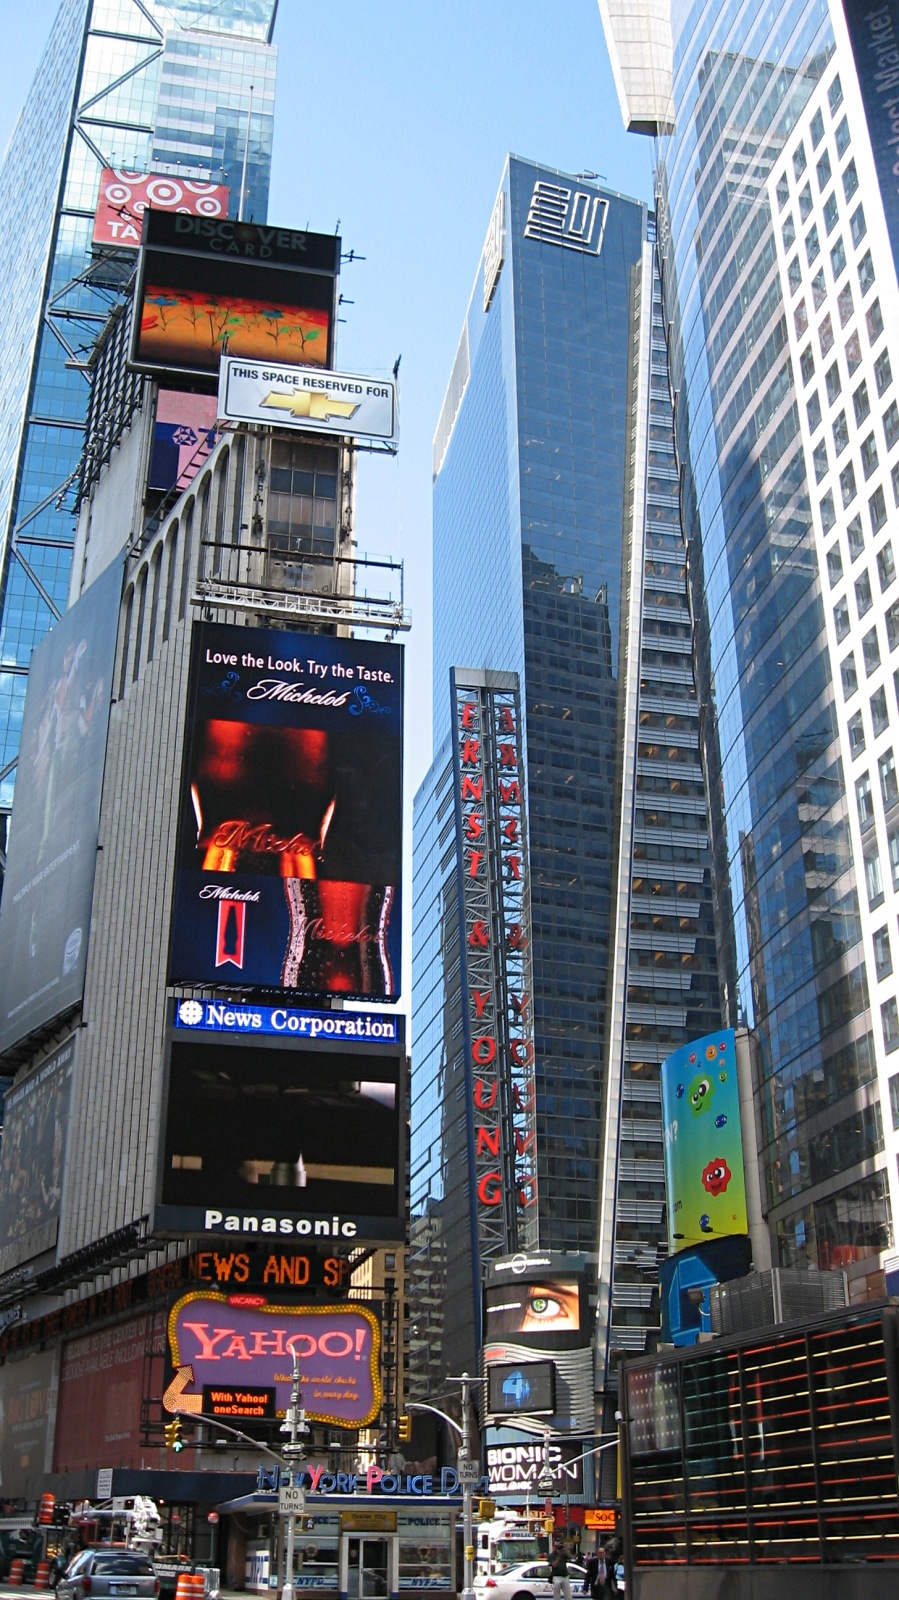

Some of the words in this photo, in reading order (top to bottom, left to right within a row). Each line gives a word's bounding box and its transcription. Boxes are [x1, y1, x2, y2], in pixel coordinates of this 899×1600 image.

[175, 215, 307, 251] DISCOVER
[210, 238, 272, 258] CARD
[232, 367, 259, 380] THIS
[262, 371, 299, 386] SPACE
[303, 377, 363, 395] RESERVED
[366, 386, 389, 398] FOR
[205, 648, 238, 666] Love
[241, 652, 264, 669] the
[267, 655, 304, 674] Look.
[307, 659, 329, 679] Try
[331, 663, 354, 680] the
[356, 665, 395, 684] Taste.
[246, 678, 352, 708] Michelob
[461, 703, 486, 878] ERNST
[199, 884, 261, 903] Michelob
[468, 919, 490, 948] &
[261, 988, 321, 998] DISTINCT
[347, 995, 392, 1003] DESIGN
[206, 1004, 261, 1028] News
[270, 1009, 395, 1038] Corporation
[471, 989, 503, 1206] YOUNG
[204, 1210, 357, 1237] Panasonic
[189, 1252, 250, 1282] NEWS
[263, 1254, 310, 1285] AND
[229, 1296, 266, 1305] VACANCY
[182, 1322, 366, 1361] YAHOO!
[211, 1391, 233, 1402] With
[234, 1392, 268, 1403] Yahoo!
[214, 1405, 264, 1417] oneSearch
[487, 1446, 562, 1466] BIONIC
[307, 1464, 360, 1492] YORK
[367, 1465, 433, 1494] POLICE
[488, 1462, 578, 1482] WOMAN
[280, 1502, 304, 1511] TURNS
[285, 1491, 299, 1500] NO
[407, 1517, 441, 1526] POLICE
[297, 1577, 324, 1586] NYPD
